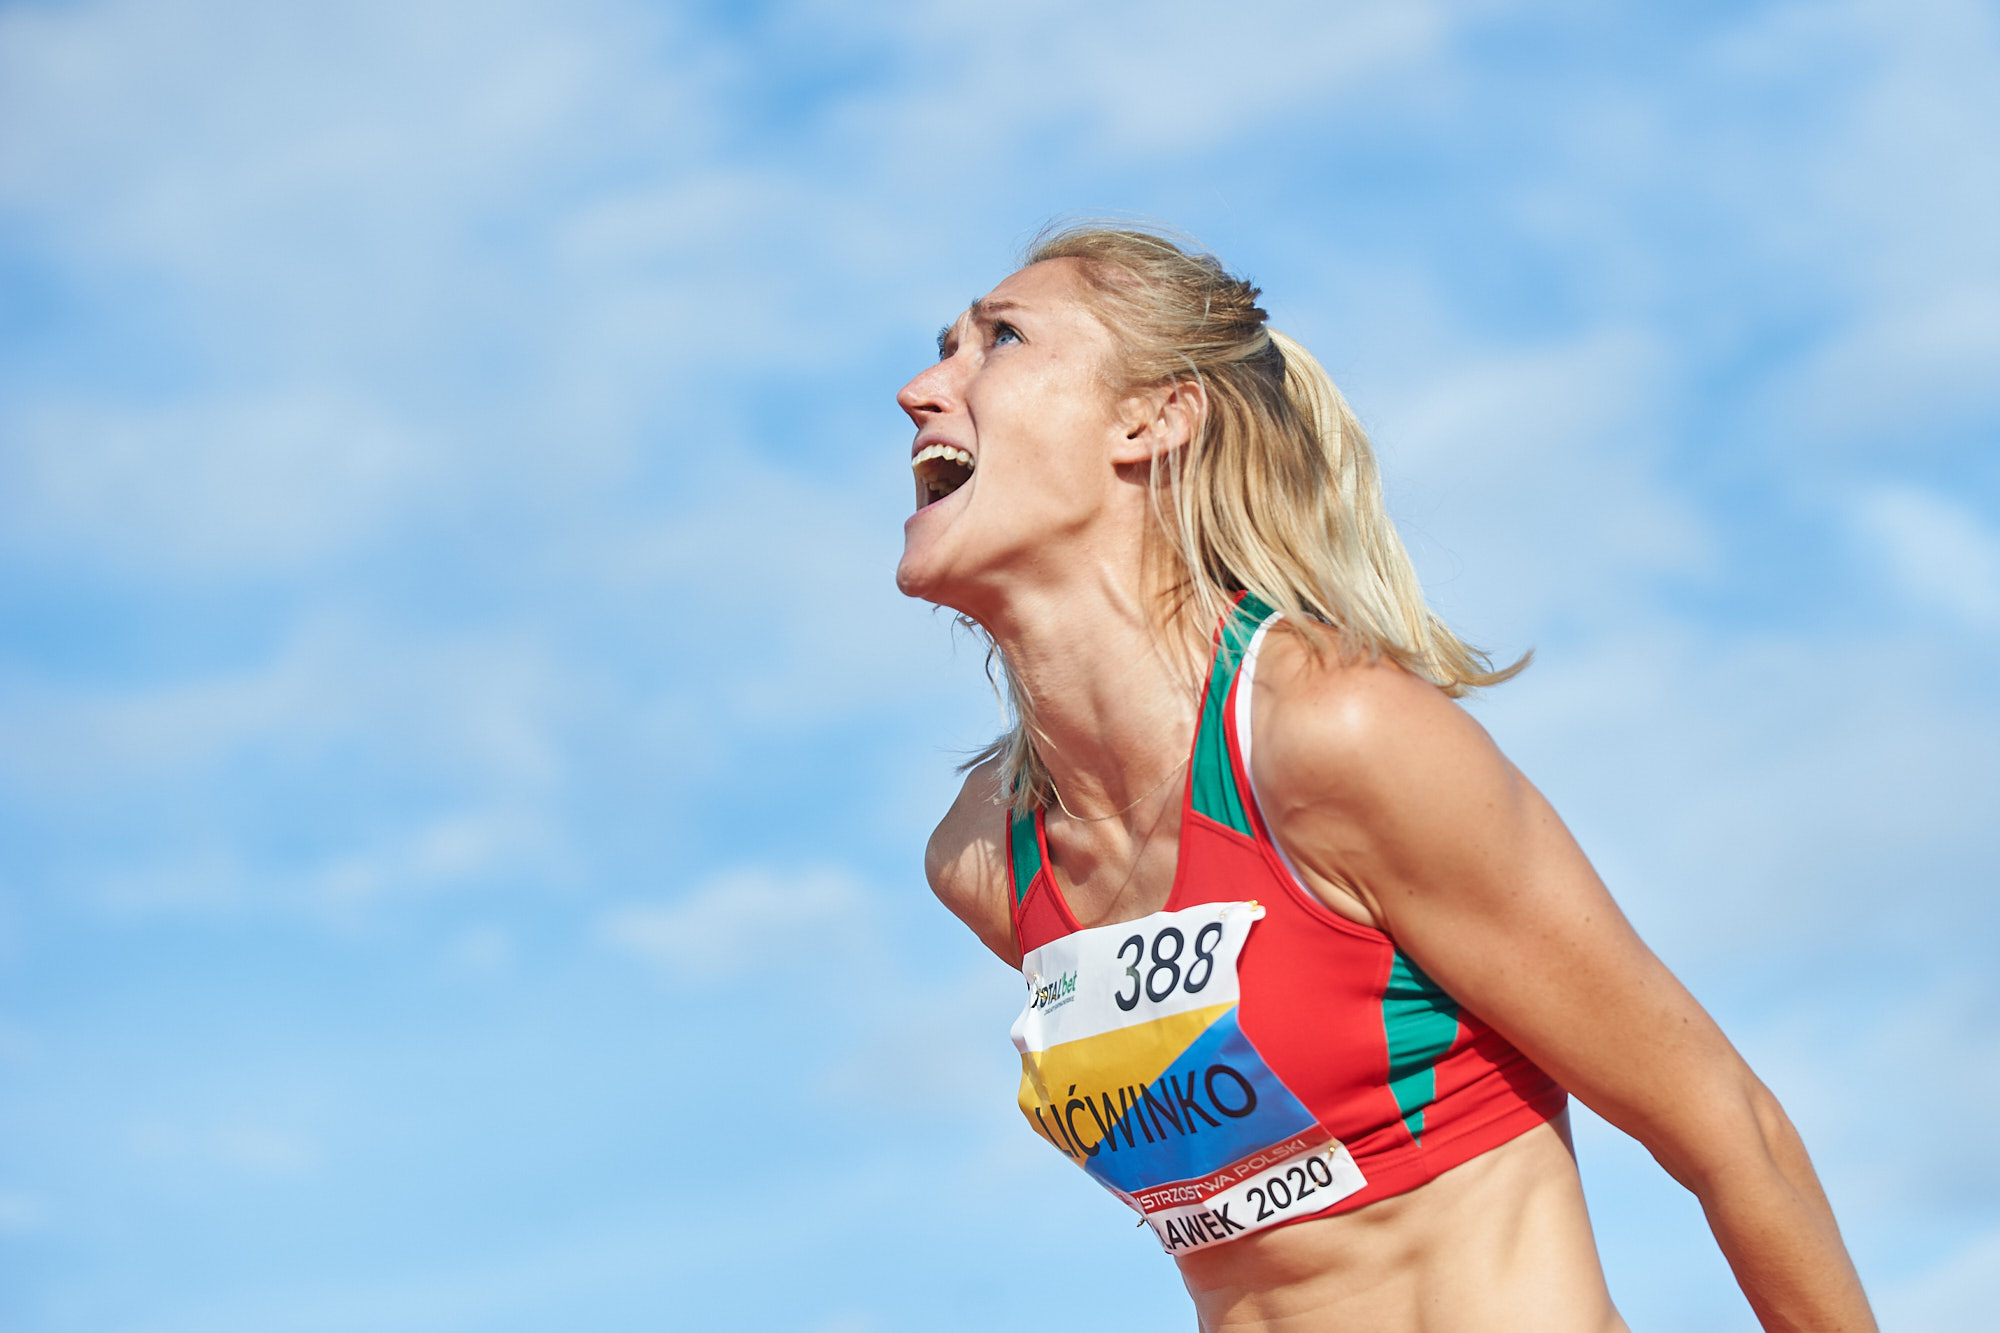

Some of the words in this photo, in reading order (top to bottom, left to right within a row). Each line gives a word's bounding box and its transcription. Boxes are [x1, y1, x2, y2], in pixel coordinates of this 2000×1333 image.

[1036, 970, 1078, 1009] OTALbet
[1115, 922, 1223, 1012] 388
[1233, 1138, 1307, 1178] POLSKI
[1246, 1156, 1333, 1222] 2020
